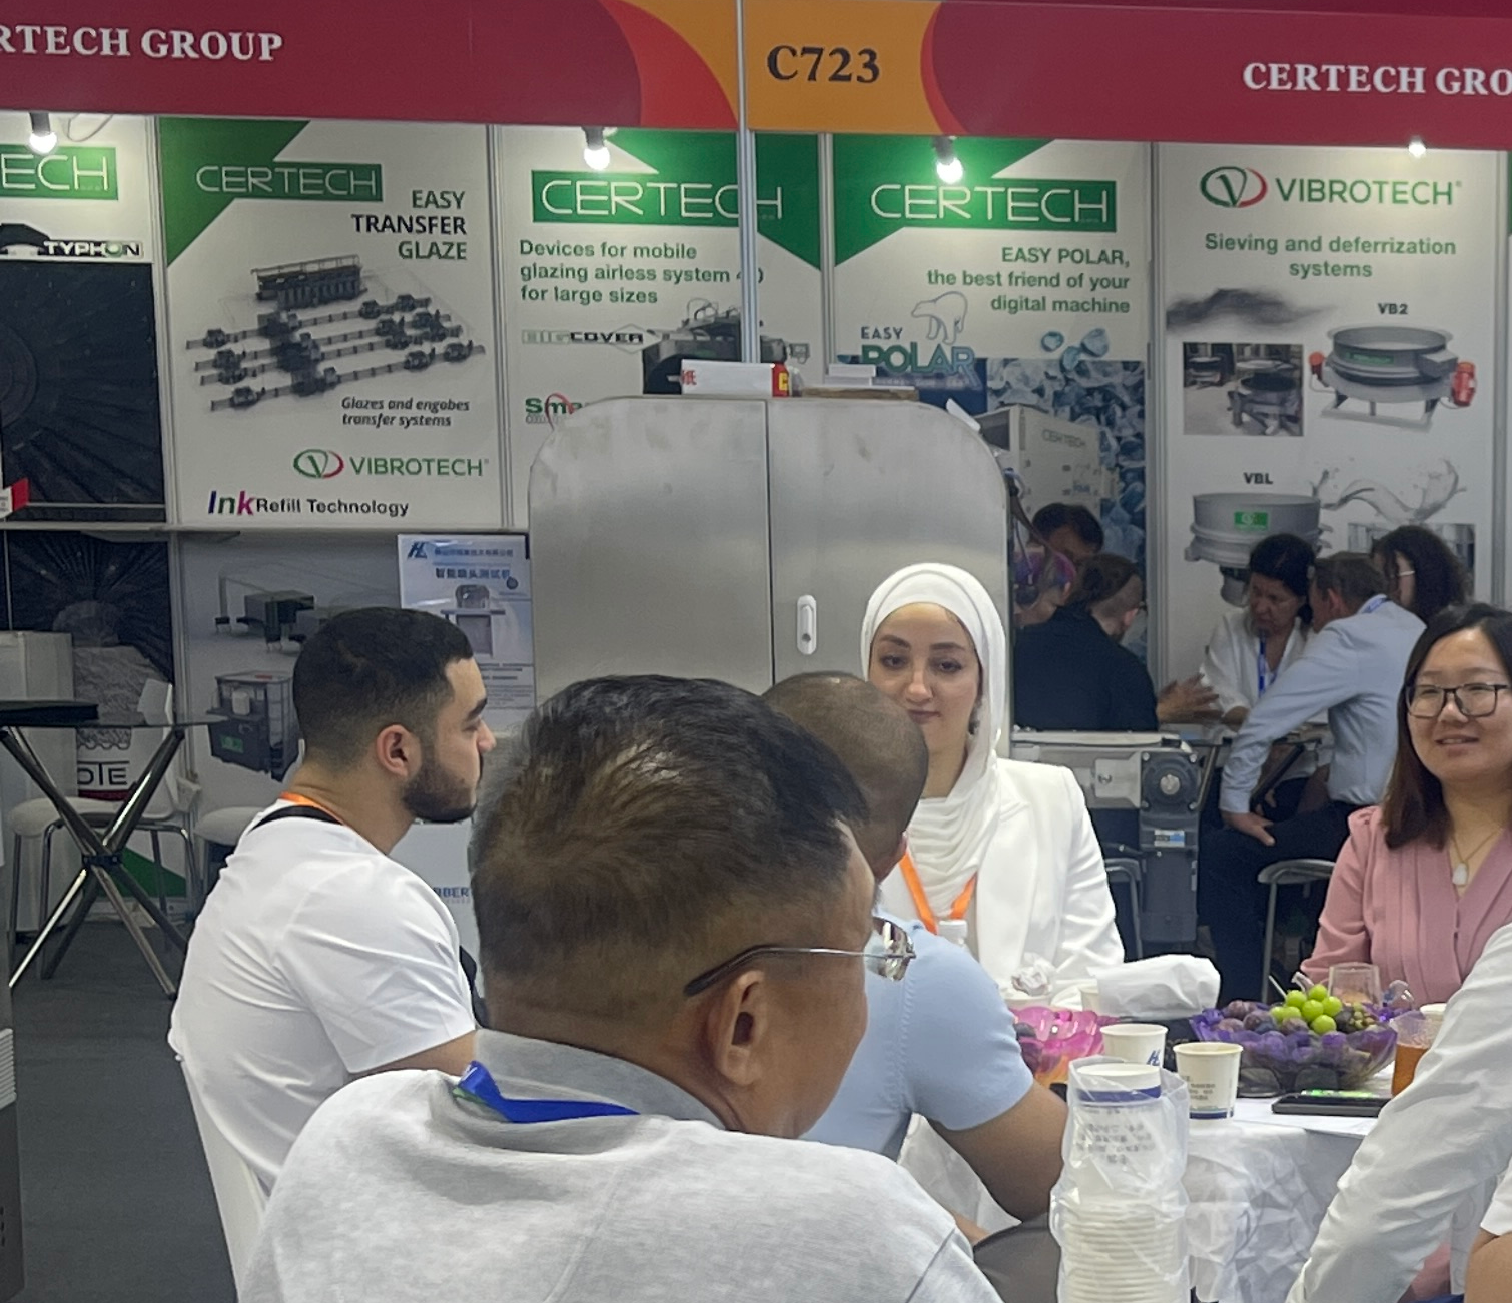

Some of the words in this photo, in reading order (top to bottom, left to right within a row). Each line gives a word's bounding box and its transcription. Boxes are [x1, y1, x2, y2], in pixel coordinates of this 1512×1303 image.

[141, 28, 282, 61] GROUP
[767, 45, 880, 83] C723
[1243, 62, 1426, 94] CERTECH
[1, 153, 108, 190] ECH
[195, 165, 377, 196] CERTECH
[412, 189, 466, 210] EASY
[870, 184, 1108, 224] CERTECH
[351, 213, 467, 235] TRANSFER
[43, 240, 142, 258] TYPHON
[398, 241, 468, 261] GLAZE
[520, 239, 595, 257] Devices
[600, 242, 628, 258] for
[633, 242, 698, 260] mobile
[1205, 233, 1278, 255] Sieving
[1285, 235, 1323, 252] and
[1329, 236, 1456, 255] deferrization
[1002, 247, 1052, 263] EASY
[1058, 249, 1131, 268] POLAR,
[520, 262, 588, 282] glazing
[594, 264, 657, 281] airless
[662, 267, 731, 285] system
[1289, 260, 1373, 279] systems
[927, 270, 957, 286] the
[962, 271, 1002, 287] best
[1008, 272, 1060, 288] friend
[1066, 274, 1084, 288] of
[1090, 277, 1130, 292] your
[521, 285, 548, 301] for
[554, 286, 603, 306] large
[609, 286, 658, 304] sizes
[991, 296, 1046, 315] digital
[1052, 297, 1131, 314] machine
[1377, 302, 1409, 315] VB2
[861, 326, 903, 340] EASY
[341, 396, 384, 411] Glazes
[388, 398, 413, 411] and
[342, 413, 396, 427] transfer
[398, 415, 452, 429] systems
[208, 490, 253, 516] Ink
[256, 498, 301, 513] Refill
[308, 499, 410, 517] Technology
